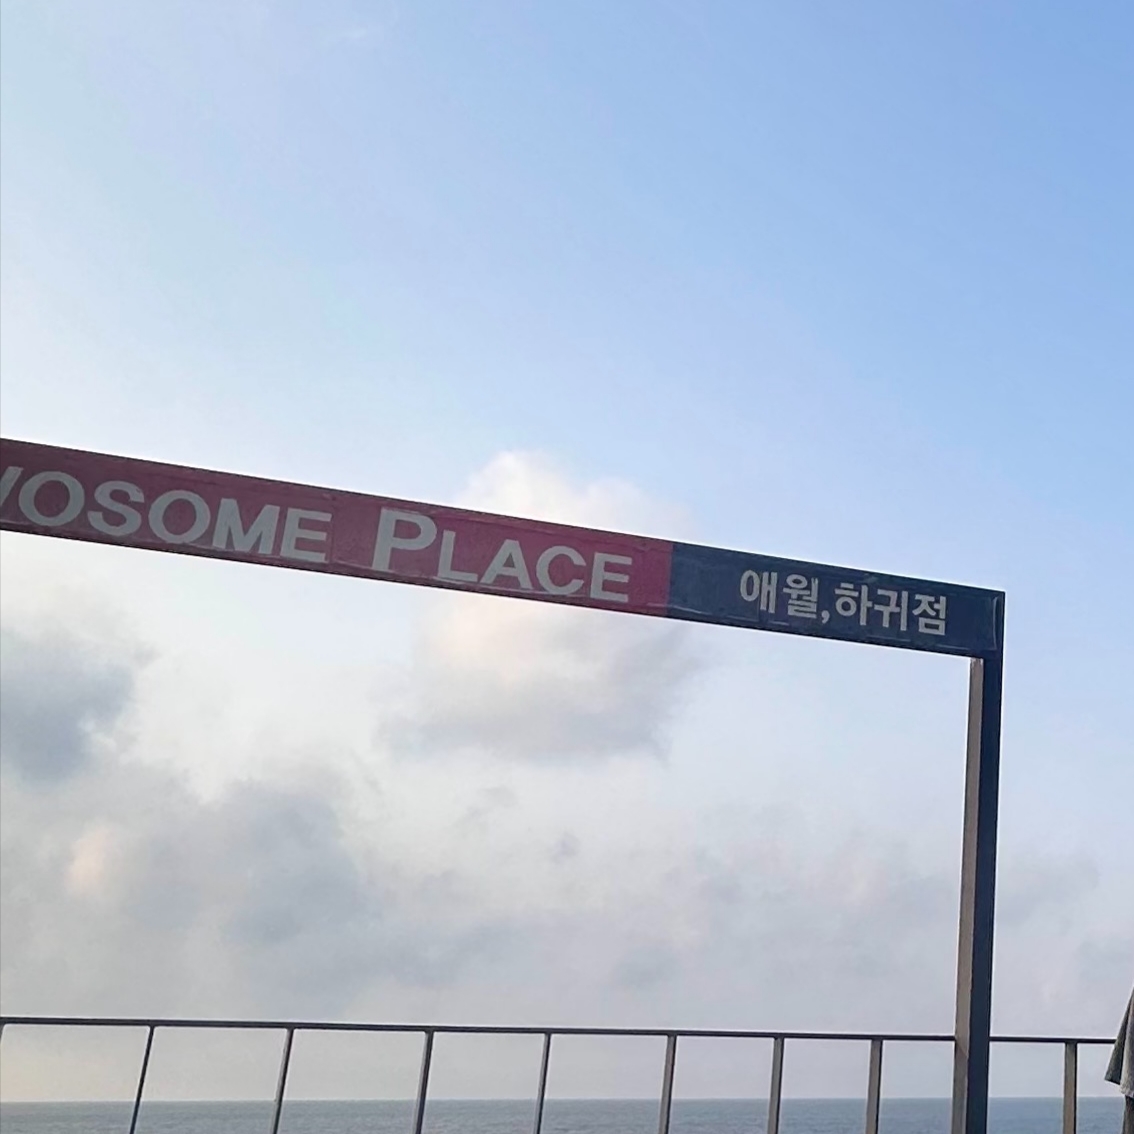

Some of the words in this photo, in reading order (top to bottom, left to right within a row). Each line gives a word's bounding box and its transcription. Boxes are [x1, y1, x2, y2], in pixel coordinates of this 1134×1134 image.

[0, 466, 332, 563] OSOME
[371, 507, 632, 602] PLACE
[739, 570, 947, 636] 애월,하귀점
